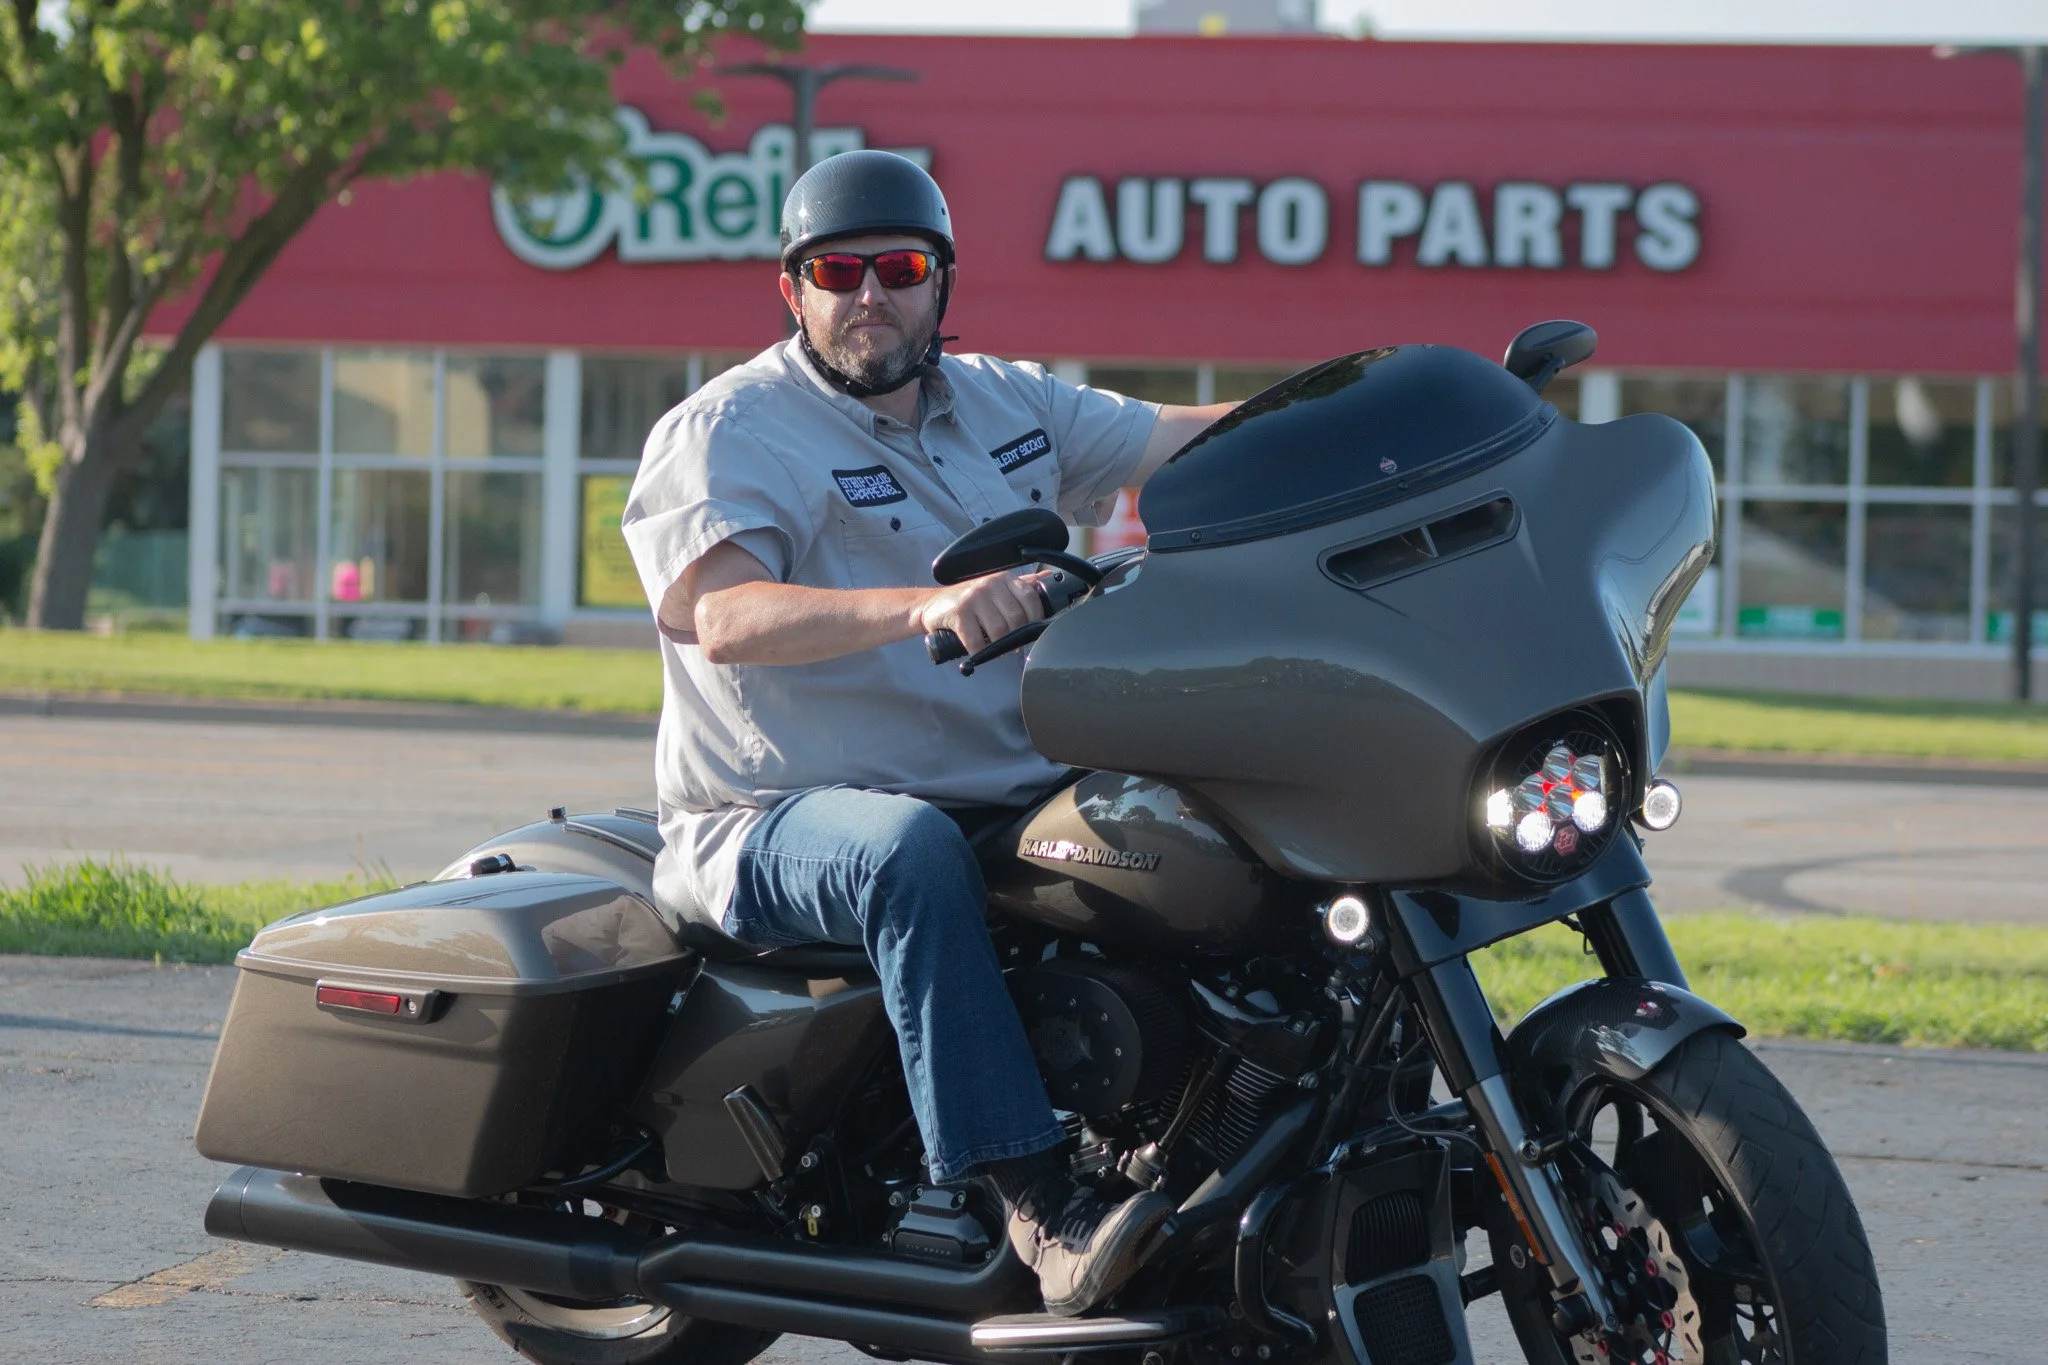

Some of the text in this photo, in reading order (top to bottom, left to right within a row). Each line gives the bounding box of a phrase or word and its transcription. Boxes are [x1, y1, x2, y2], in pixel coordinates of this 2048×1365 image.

[1046, 177, 1328, 264] AUTO
[1356, 181, 1701, 272] PARTS
[993, 449, 1020, 469] LENT
[838, 472, 891, 489] STRIP CLUB
[845, 484, 896, 501] CHOPPERS
